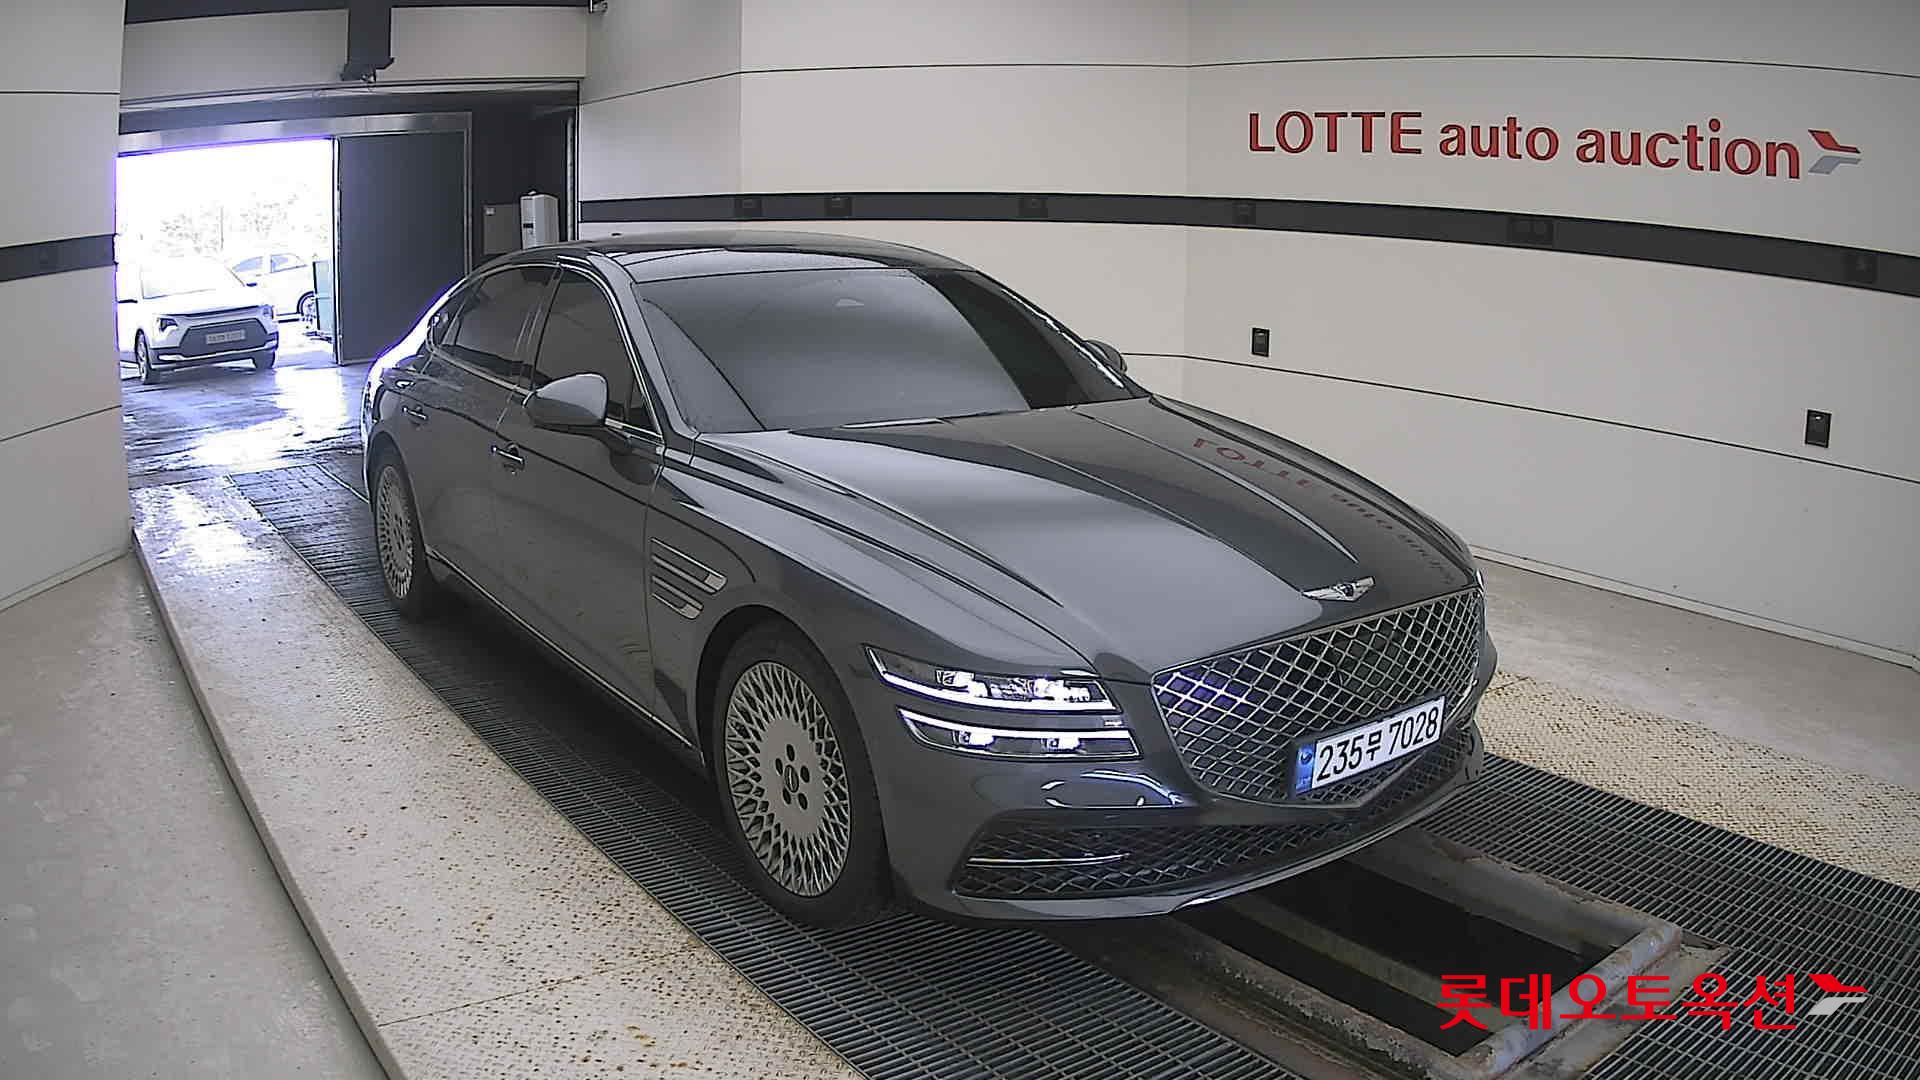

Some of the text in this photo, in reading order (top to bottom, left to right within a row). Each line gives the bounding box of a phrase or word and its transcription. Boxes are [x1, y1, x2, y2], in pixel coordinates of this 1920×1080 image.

[1249, 111, 1800, 179] LOTTE auto auction
[1317, 706, 1440, 781] 235무 7028
